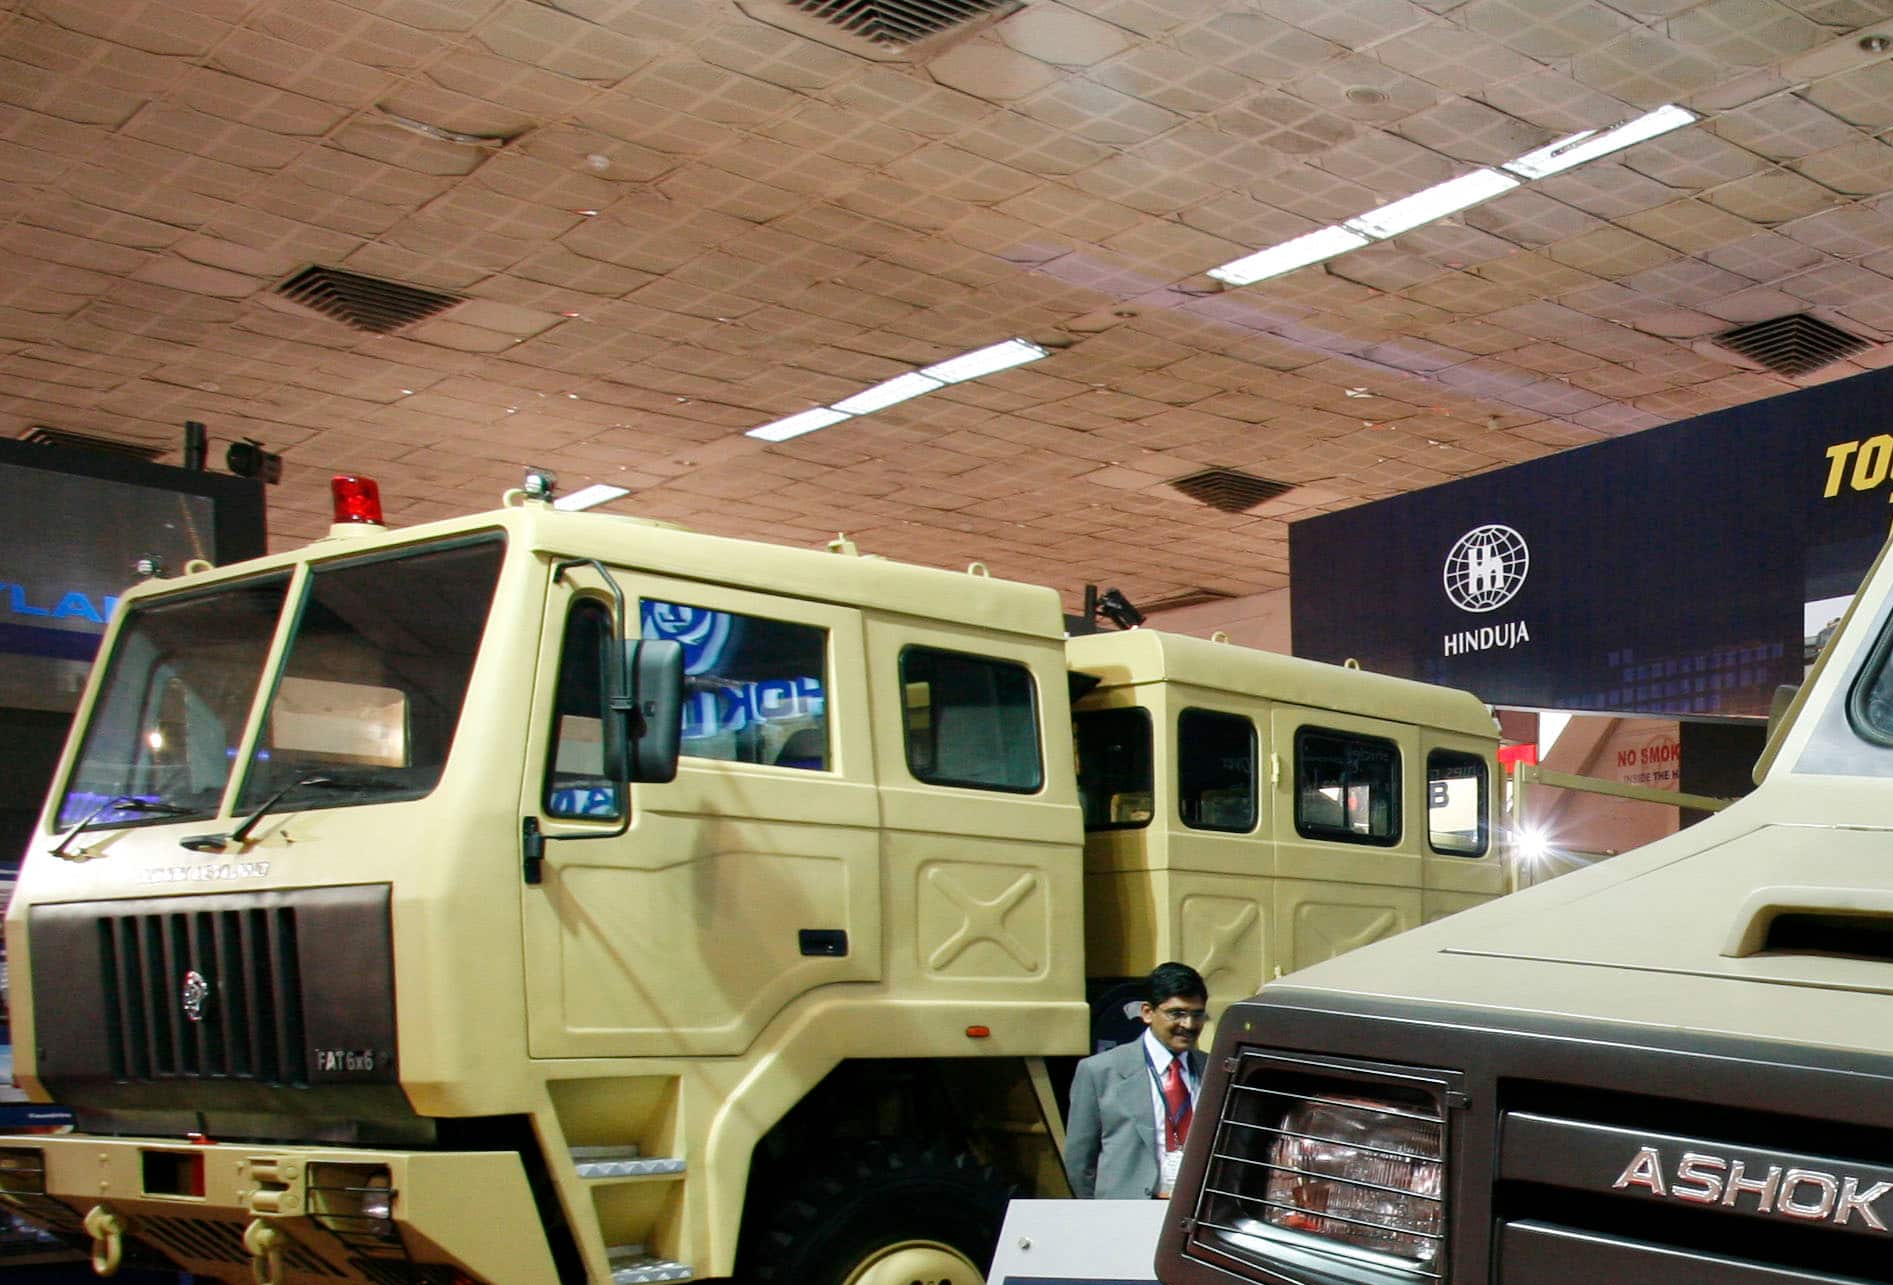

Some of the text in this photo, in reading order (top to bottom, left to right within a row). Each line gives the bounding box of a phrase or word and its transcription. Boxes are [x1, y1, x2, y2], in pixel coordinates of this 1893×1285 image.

[1444, 620, 1530, 657] HINDUJA
[1617, 750, 1637, 767] NO
[1653, 771, 1670, 781] THE
